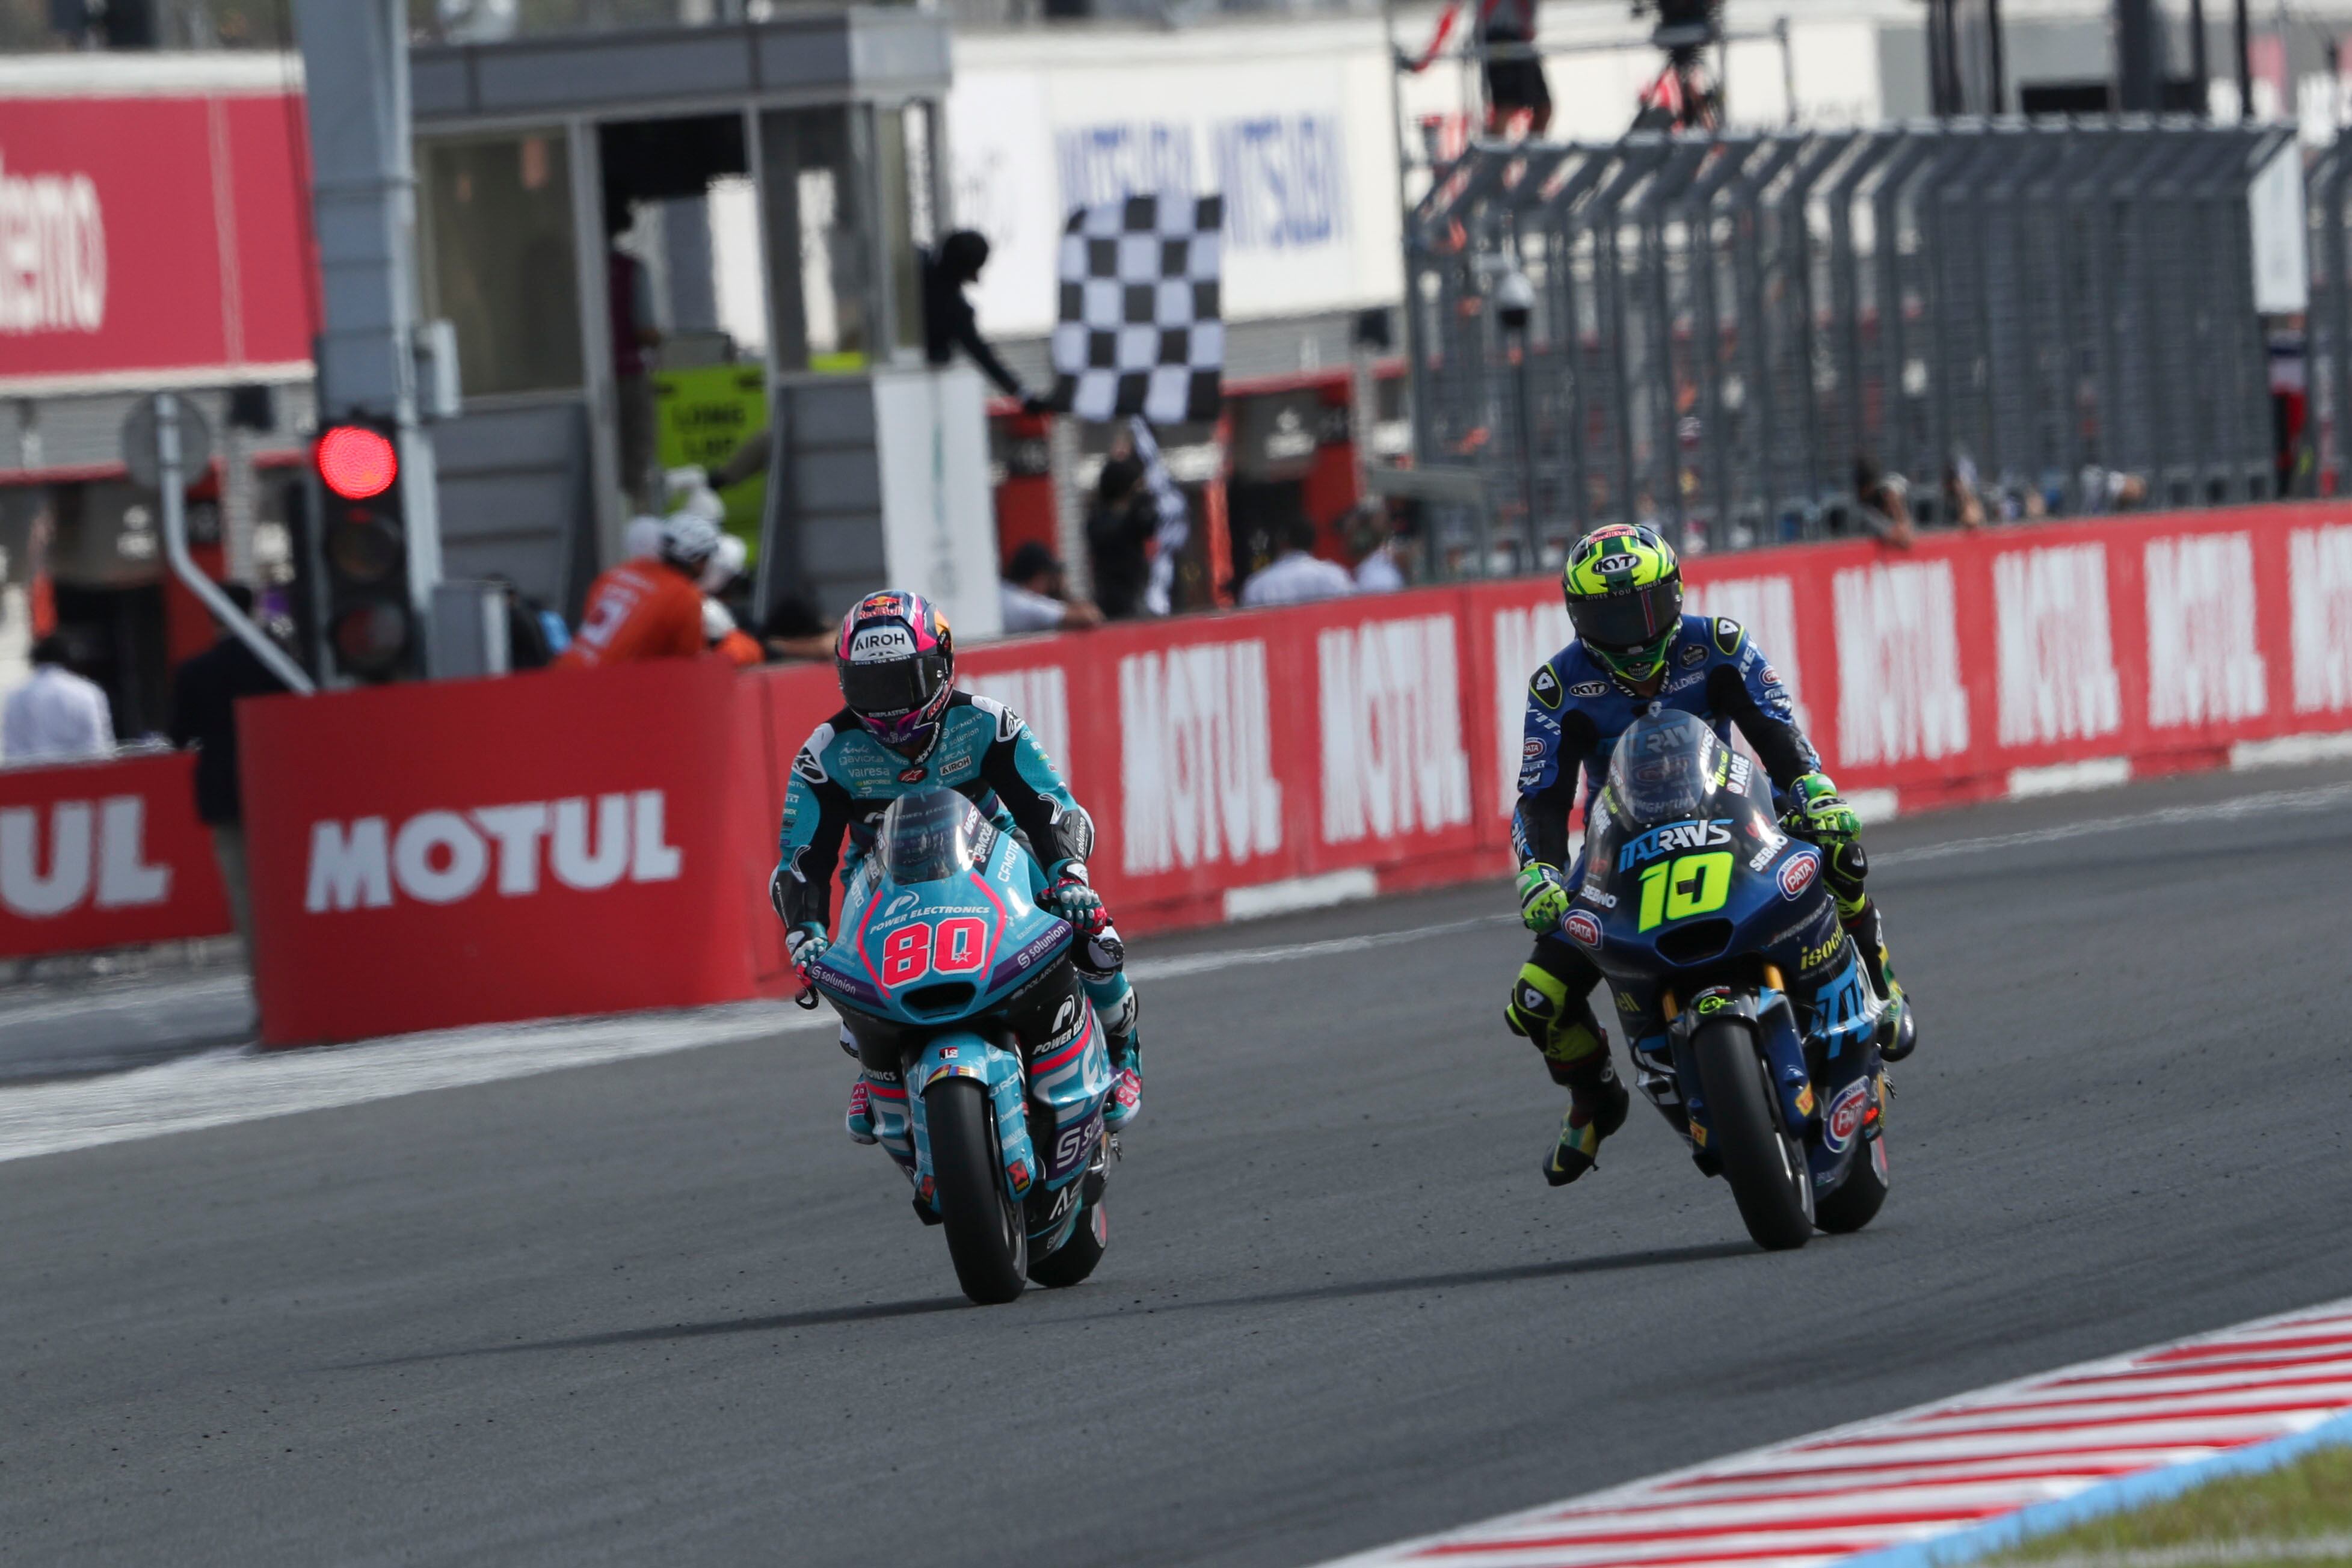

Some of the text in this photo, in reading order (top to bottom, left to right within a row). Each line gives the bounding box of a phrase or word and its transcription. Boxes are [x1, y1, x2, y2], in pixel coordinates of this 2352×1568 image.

[1594, 556, 1635, 572] KYT
[1612, 588, 1631, 597] YOU
[854, 633, 905, 651] AIROH
[2144, 531, 2268, 730] MOTUL
[1993, 542, 2122, 749] MOTUL
[1832, 559, 1969, 768] MOTUL
[1574, 683, 1605, 695] KYT
[949, 727, 980, 746] solunion
[1318, 613, 1471, 844] MOTUL
[838, 755, 884, 766] gaviota
[941, 757, 971, 775] AIROH
[1118, 637, 1282, 877] MOTUL
[848, 767, 890, 778] valresa
[306, 789, 682, 913] MOTUL
[997, 839, 1020, 883] CFMOTO
[1787, 862, 1813, 890] PATA
[1637, 850, 1734, 934] 10
[870, 905, 991, 935] POWER ELECTRONICS
[1569, 921, 1593, 941] PATA
[881, 916, 988, 989] 80
[1028, 925, 1067, 958] solunion
[820, 971, 857, 995] solunion
[1032, 1028, 1073, 1056] POWER
